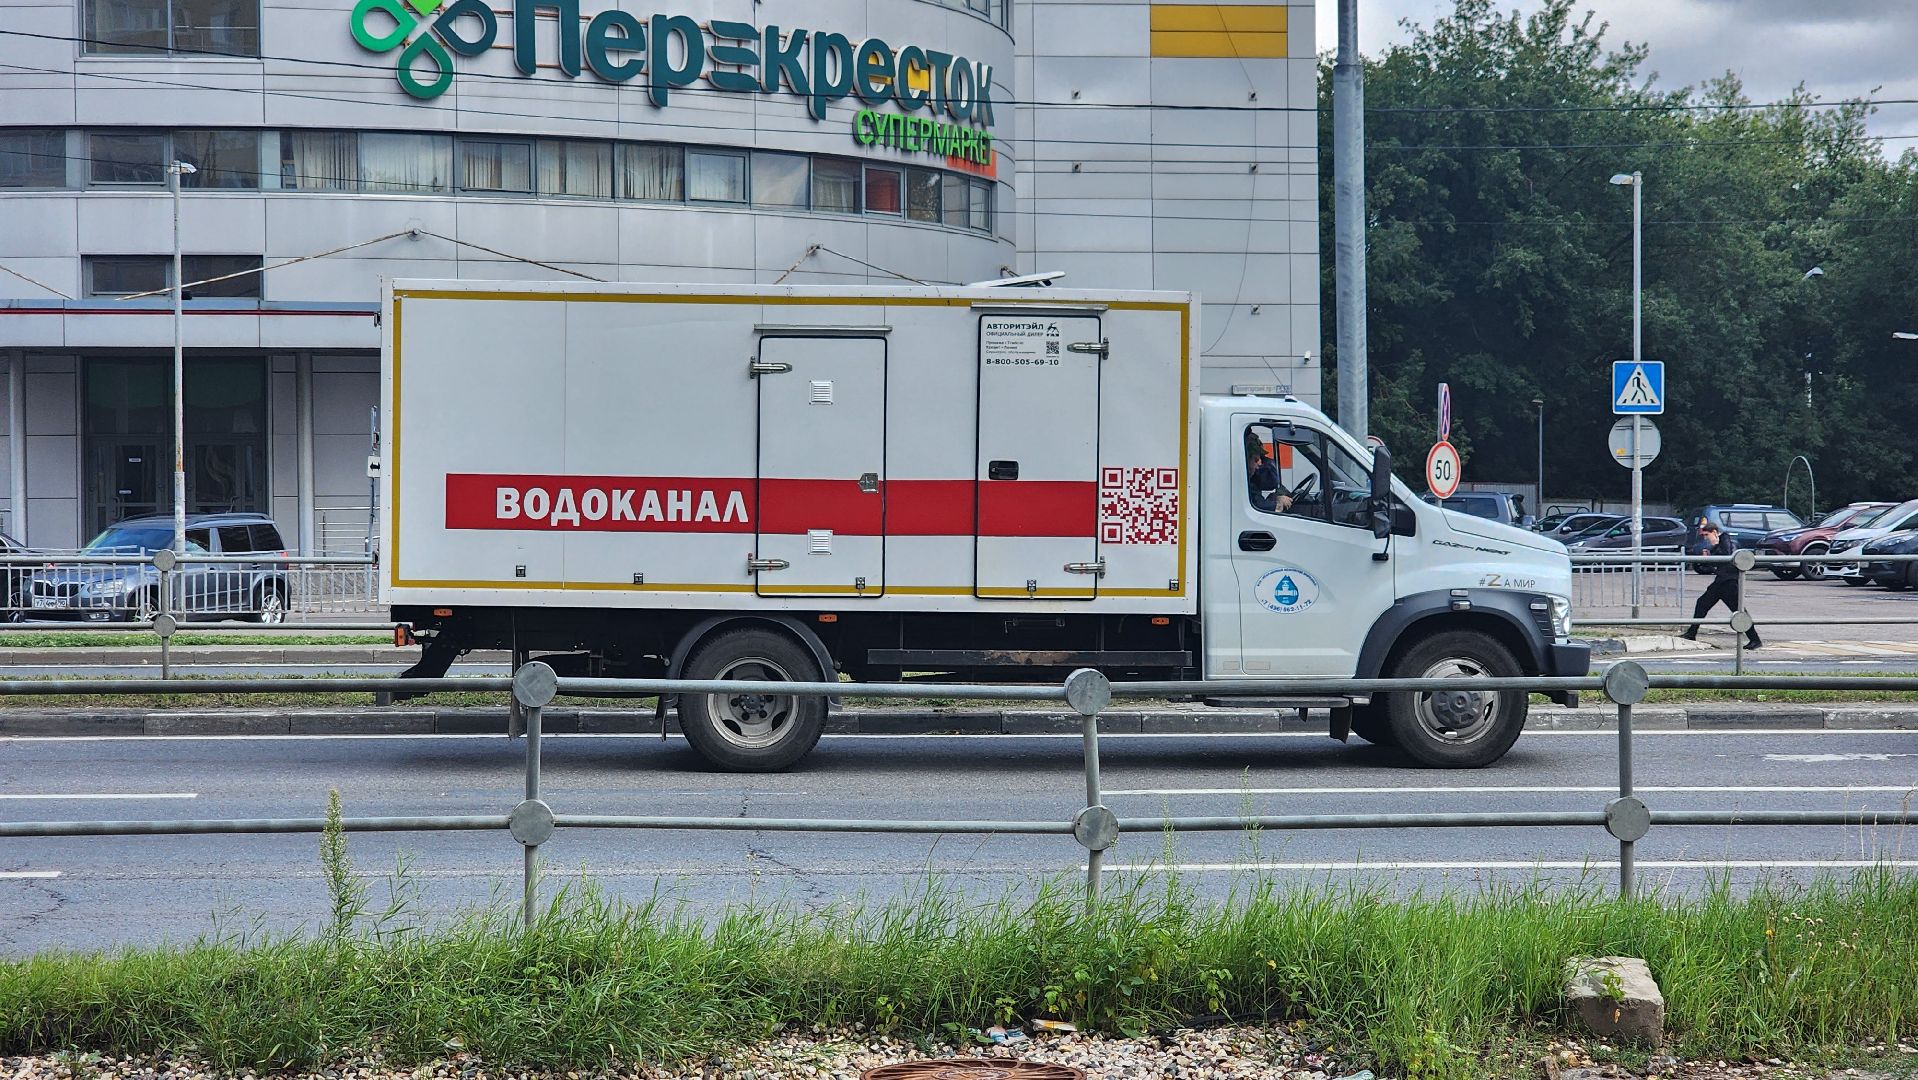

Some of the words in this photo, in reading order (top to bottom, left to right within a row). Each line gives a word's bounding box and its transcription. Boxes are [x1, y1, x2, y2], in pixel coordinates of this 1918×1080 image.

[513, 0, 996, 126] Перекресток
[853, 108, 994, 166] СУПЕРМАРКЕТ
[986, 322, 1044, 330] АВТОРИТЭЙЛ
[986, 358, 1059, 366] 8-800-505-69-10
[1435, 460, 1451, 480] 50
[496, 487, 749, 526] ВОДОКАНАЛ
[1514, 579, 1536, 588] МИР
